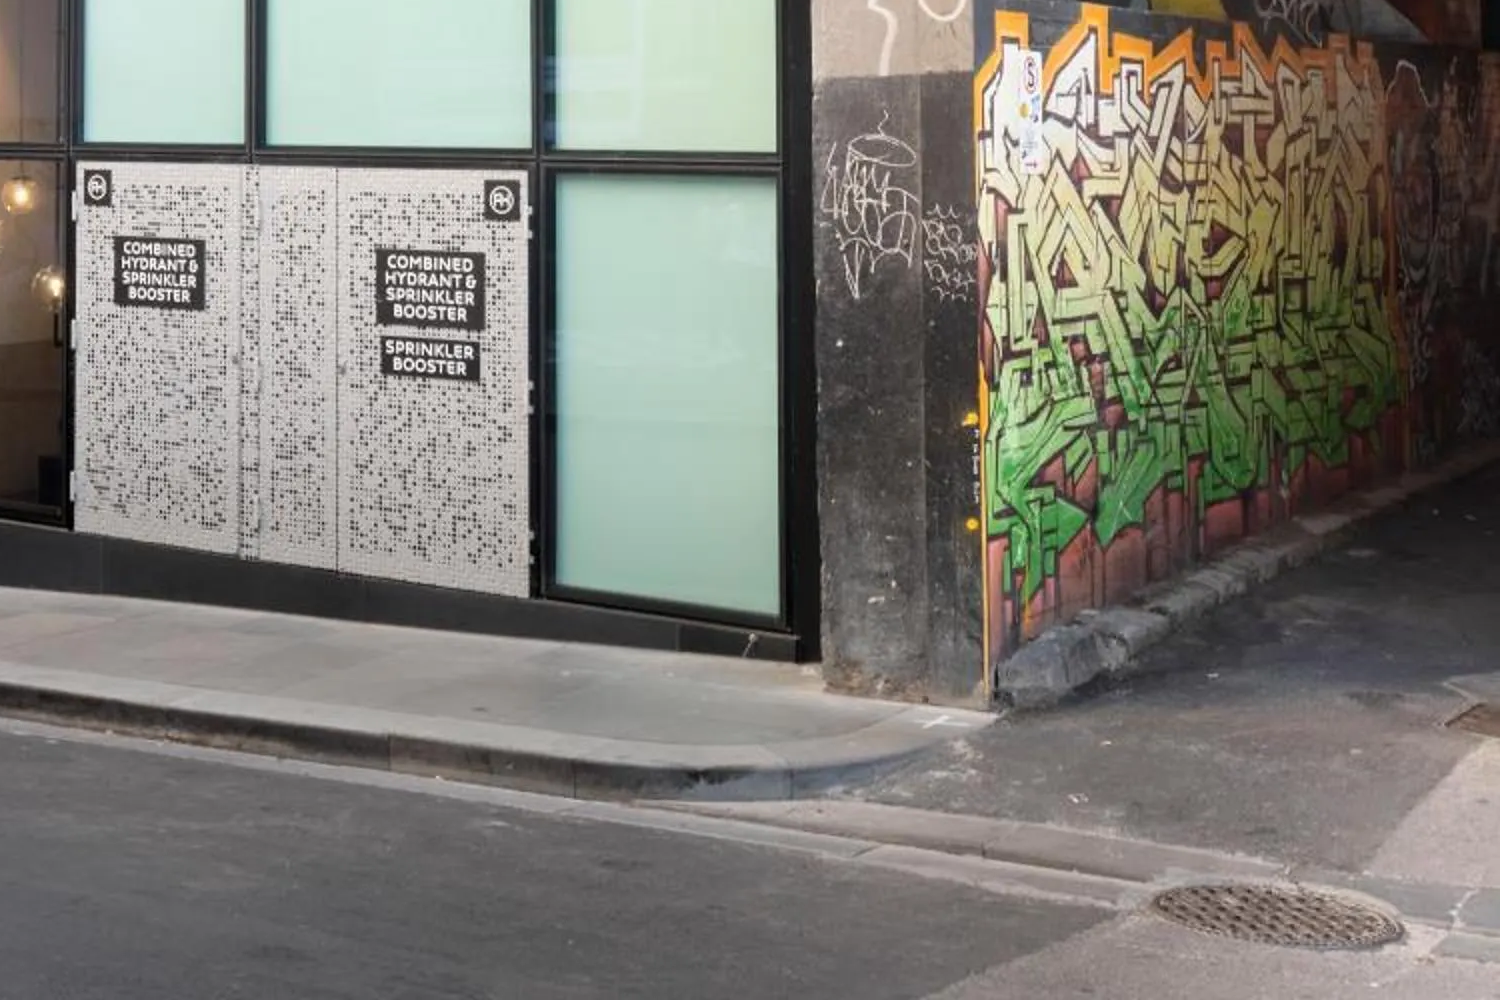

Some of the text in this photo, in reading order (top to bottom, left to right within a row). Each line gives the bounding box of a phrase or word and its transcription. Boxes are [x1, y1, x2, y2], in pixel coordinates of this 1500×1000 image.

[123, 241, 196, 257] COMBINED
[121, 256, 199, 273] HYDRANT &
[387, 254, 474, 272] COMBINED
[122, 271, 197, 288] SPRINKLER
[384, 271, 477, 289] HYDRANT &
[128, 286, 191, 303] BOOSTER
[385, 287, 476, 306] SPRINKLER
[393, 304, 468, 322] BOOSTER
[385, 340, 475, 360] SPRINKLER
[392, 357, 468, 376] BOOSTER
